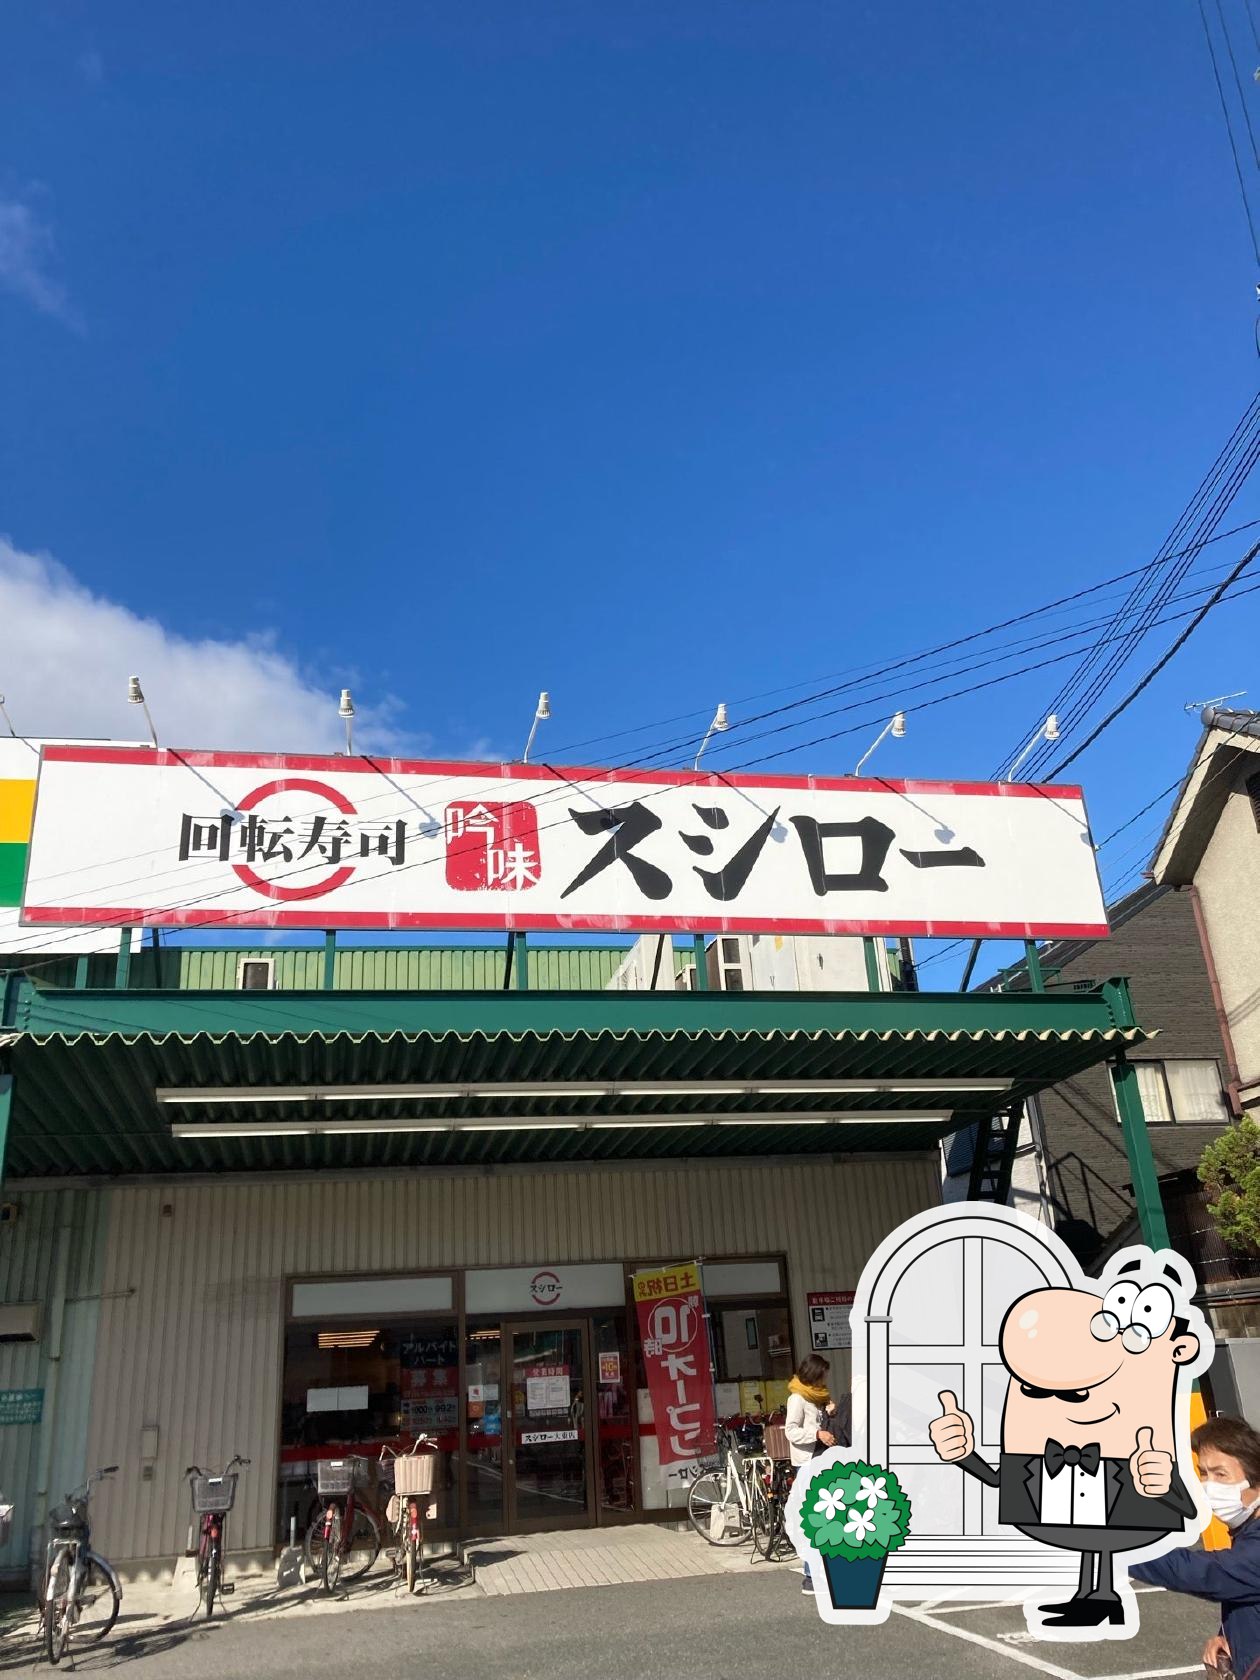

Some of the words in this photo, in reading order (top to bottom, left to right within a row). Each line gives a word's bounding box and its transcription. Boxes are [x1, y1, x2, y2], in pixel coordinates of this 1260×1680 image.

[178, 812, 406, 866] 回転寿司
[446, 802, 539, 887] 吟味
[560, 801, 985, 901] スシロー
[529, 1284, 563, 1293] スシロー
